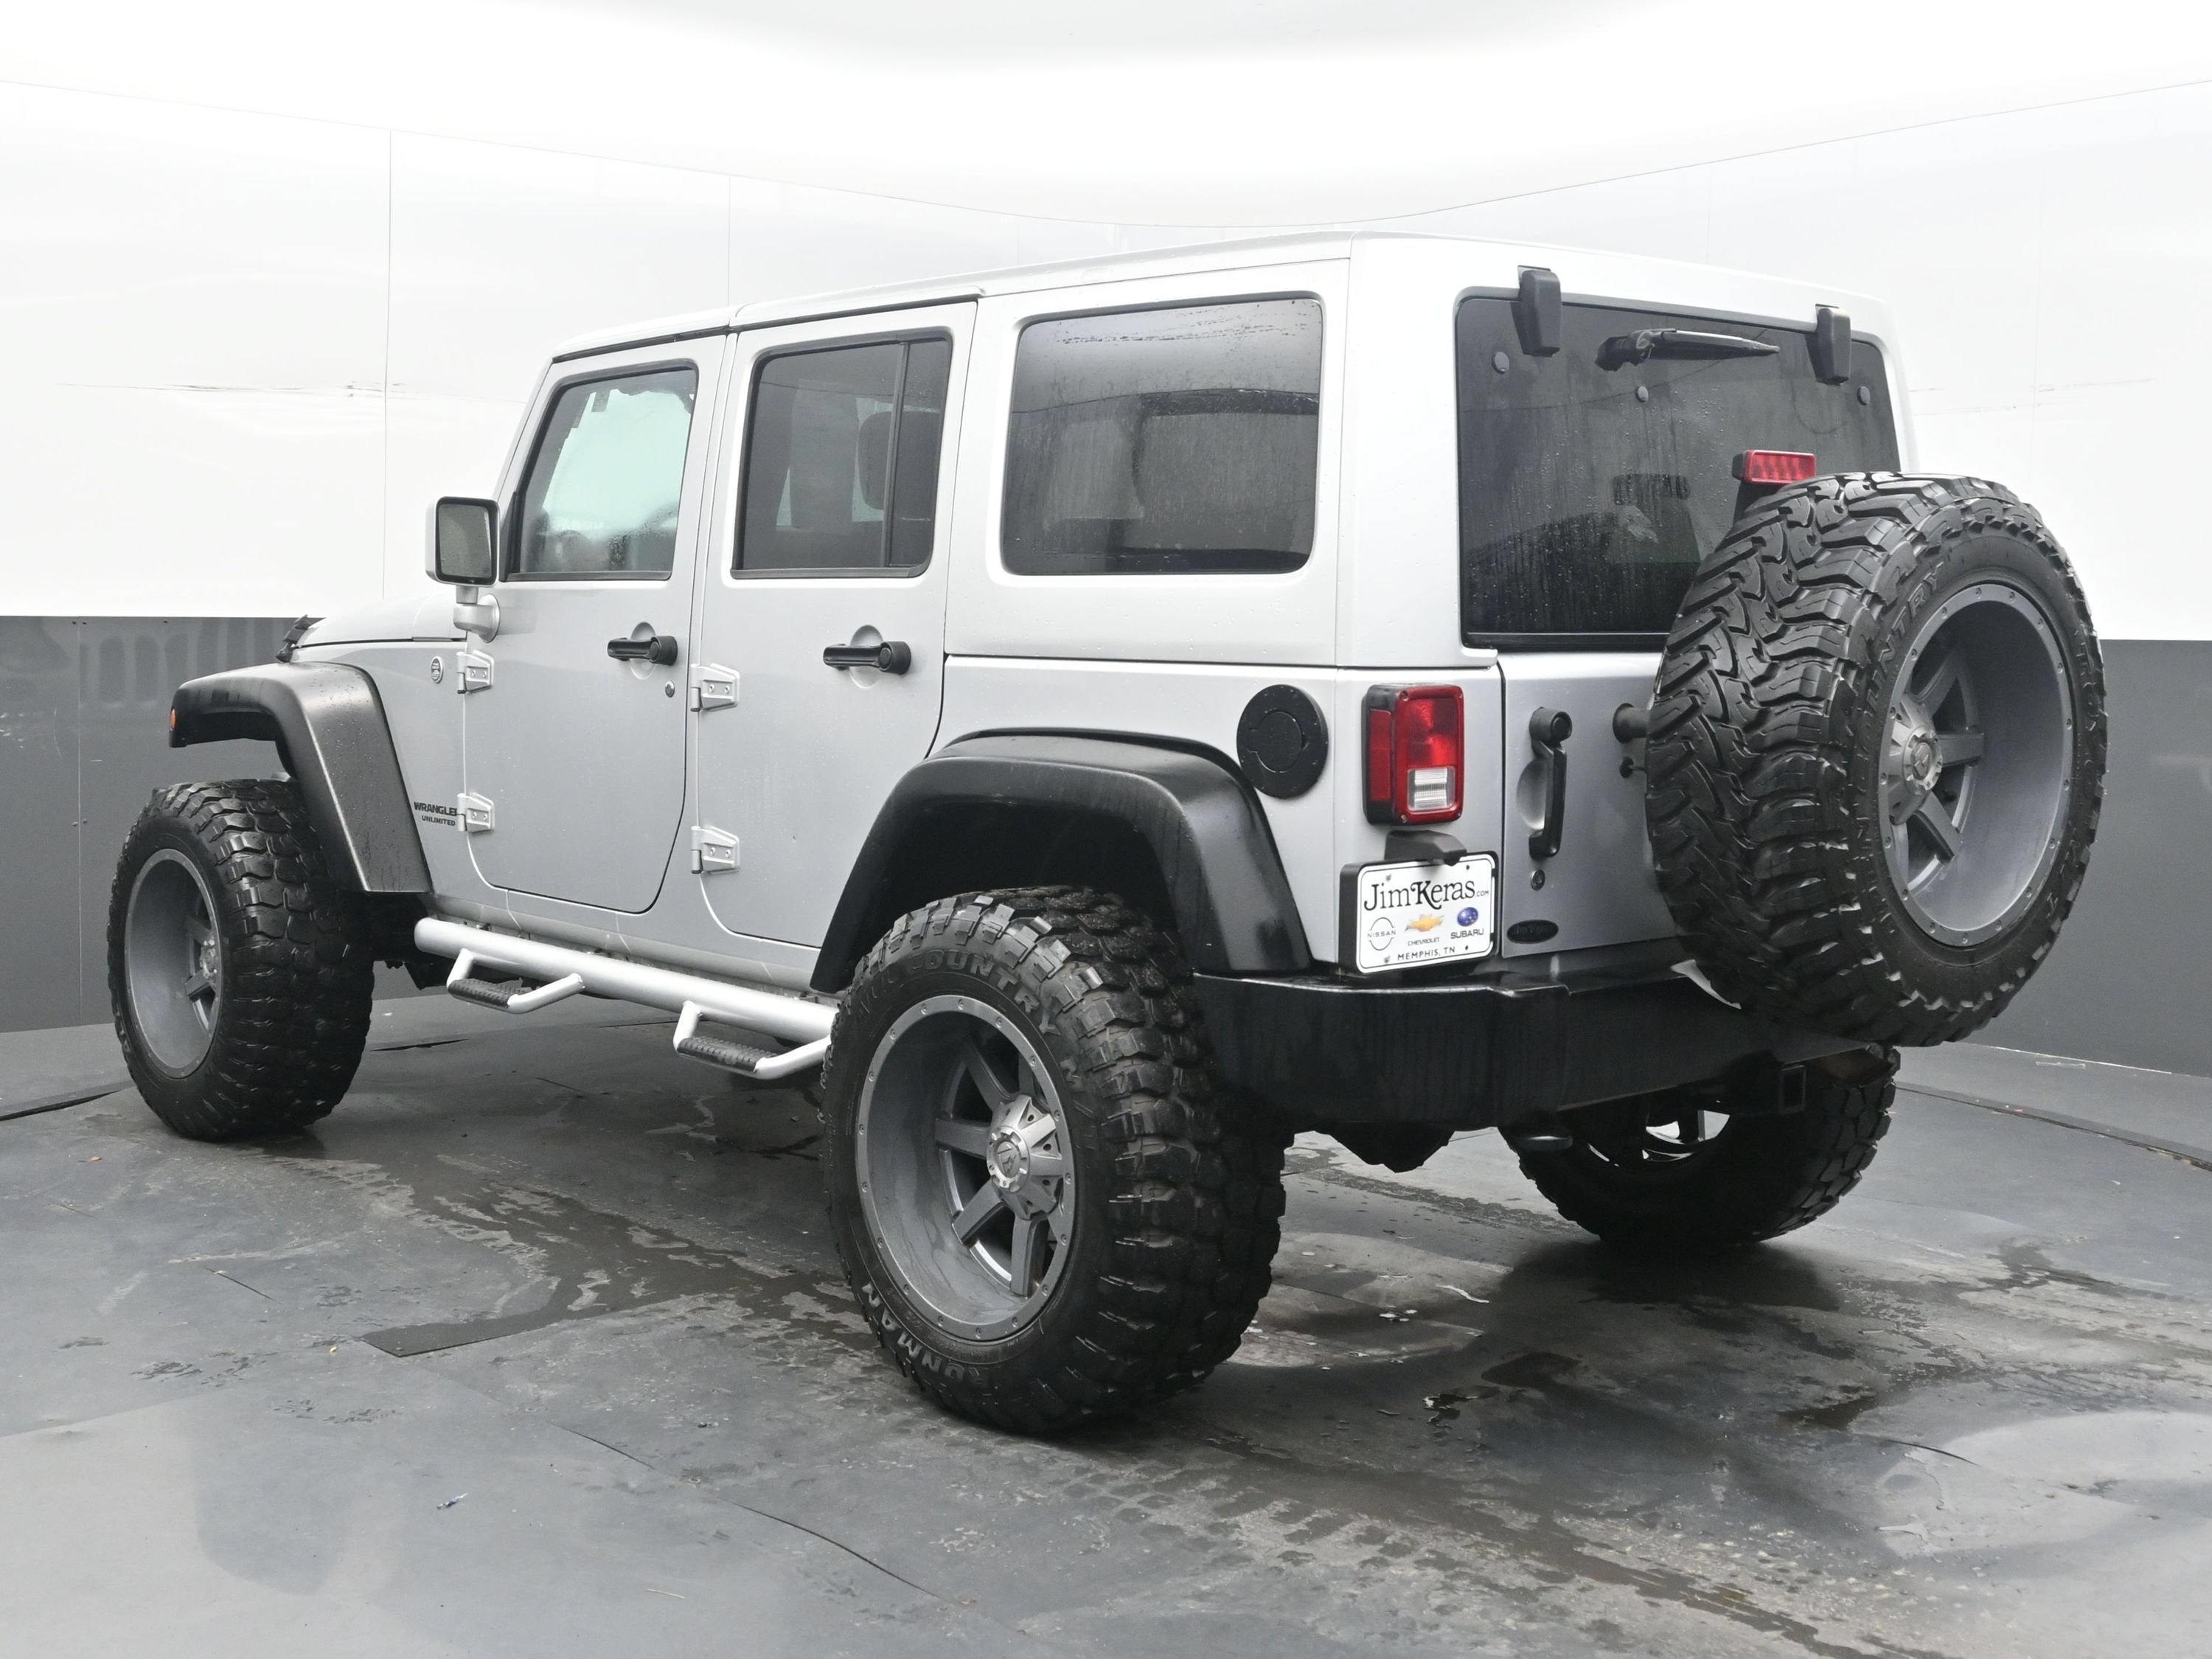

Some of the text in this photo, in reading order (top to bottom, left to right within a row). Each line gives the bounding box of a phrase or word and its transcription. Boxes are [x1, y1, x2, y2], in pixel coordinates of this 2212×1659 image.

[414, 801, 457, 817] WRANGLE
[421, 815, 456, 827] UNLIMITED
[1367, 930, 1397, 939] NISSAN
[1450, 928, 1484, 939] SUBARU
[1408, 936, 1440, 947] CHEVROLET
[1397, 946, 1455, 961] MEMPHIS, TN
[911, 949, 1062, 1036] COUNTRY
